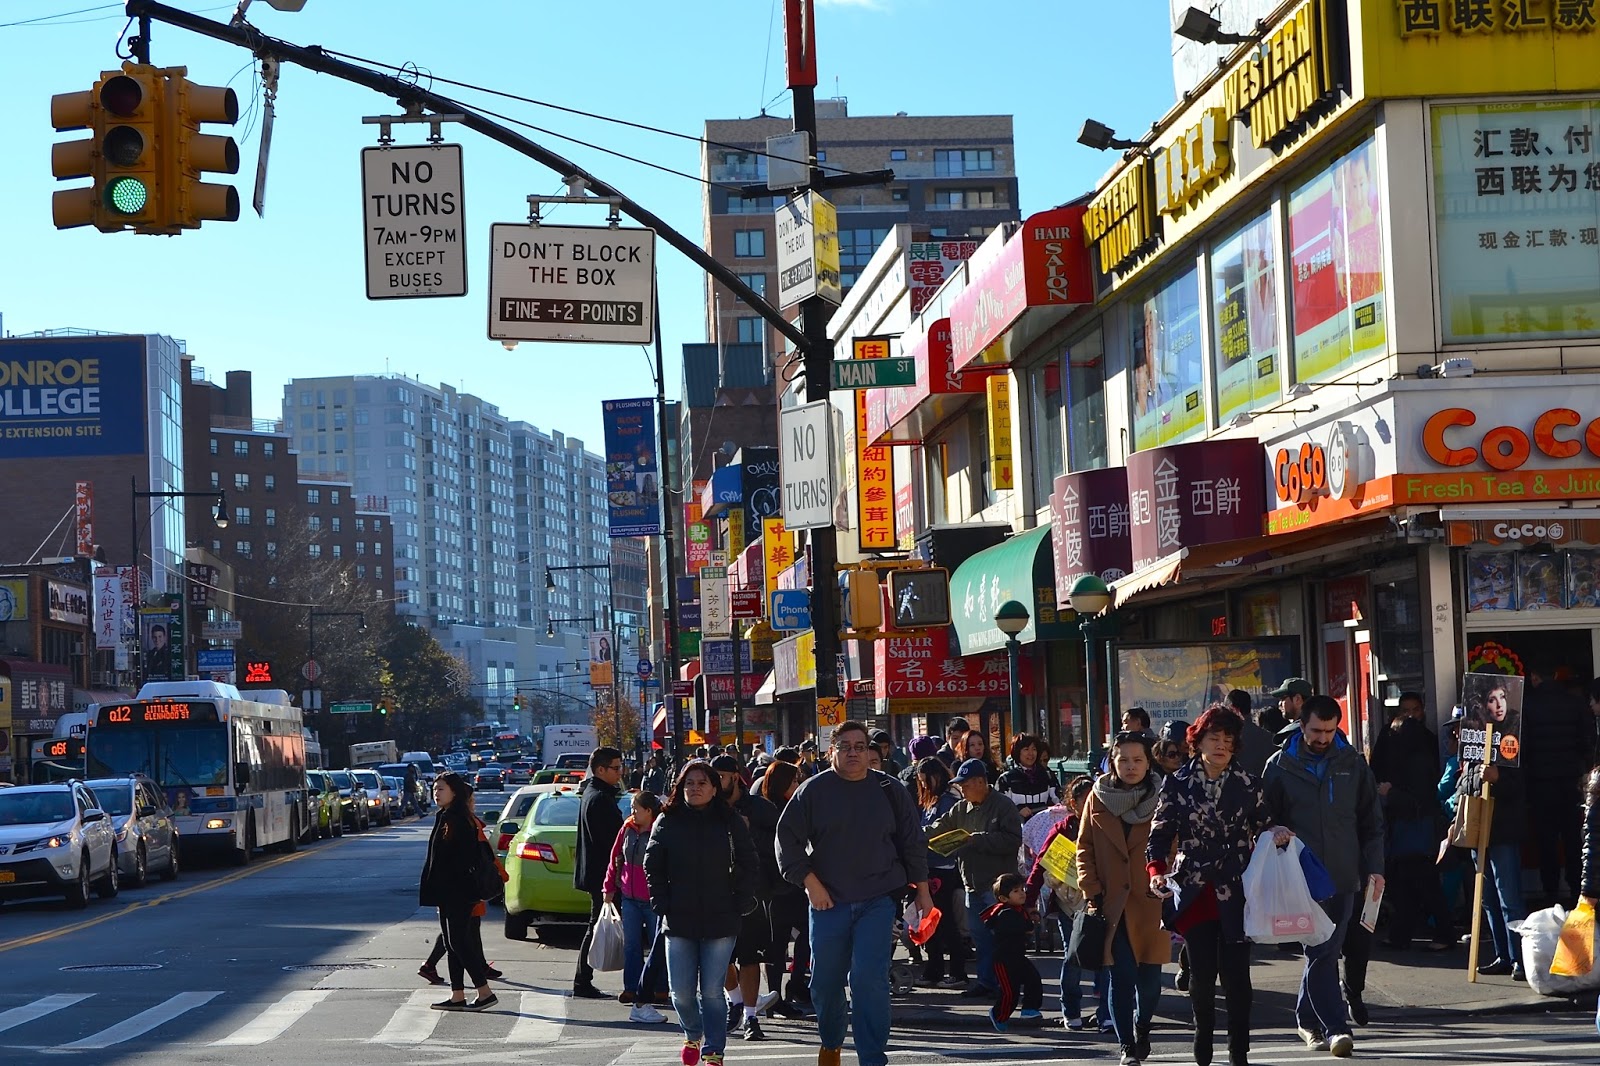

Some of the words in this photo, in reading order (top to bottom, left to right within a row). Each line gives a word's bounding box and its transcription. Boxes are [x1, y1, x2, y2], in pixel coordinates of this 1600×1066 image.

[1404, 0, 1596, 31] 西联汇款
[1223, 3, 1312, 121] WESTERN
[1250, 55, 1317, 149] UNION
[391, 161, 433, 184] NO
[371, 192, 456, 217] TURNS
[1082, 163, 1139, 241] WESTERN
[373, 226, 456, 245] 7AM-9PM
[778, 218, 793, 238] DON'T
[1034, 227, 1070, 241] HAIR
[503, 242, 565, 260] DON'T
[572, 244, 641, 263] BLOCK
[785, 238, 795, 256] THE
[796, 232, 806, 251] BOX
[1099, 210, 1139, 274] UNION
[385, 251, 446, 267] EXCEPT
[389, 273, 443, 288] BUSES
[529, 266, 568, 284] THE
[576, 269, 616, 286] BOX
[781, 271, 791, 290] FINE
[797, 260, 812, 283] POINTS
[1045, 242, 1070, 300] SALON
[504, 301, 540, 320] FINE
[548, 303, 574, 320] +2
[581, 304, 637, 323] POINTS
[937, 331, 952, 342] HA
[838, 363, 876, 386] MAIN
[897, 360, 910, 373] ST
[0, 387, 101, 416] LLEGE
[615, 401, 641, 409] FLUSHING
[616, 416, 642, 424] BLOCK
[5, 425, 73, 439] EXTENSION
[76, 425, 102, 437] SITE
[617, 427, 642, 436] PARTY
[793, 424, 815, 462] NO
[786, 477, 827, 512] TURNS
[1191, 478, 1241, 516] 西餅
[1407, 479, 1474, 498] Fresh
[1482, 476, 1524, 496] Tea
[1533, 476, 1550, 494] &
[1154, 457, 1181, 549] 金陵
[1062, 484, 1083, 569] 金陵
[1088, 503, 1129, 538] 西餅
[101, 579, 115, 637] 美的世界
[781, 606, 808, 614] Phone
[888, 647, 932, 658] Salon
[889, 637, 933, 647] HAIR
[887, 680, 1011, 696] (718)463-495
[109, 706, 131, 722] Q12
[146, 705, 169, 714] LITTLE
[171, 704, 189, 712] NECK
[1145, 700, 1160, 708] time
[1164, 709, 1188, 717] BETTER
[144, 712, 179, 721] GLENWOOD
[181, 711, 190, 719] ST
